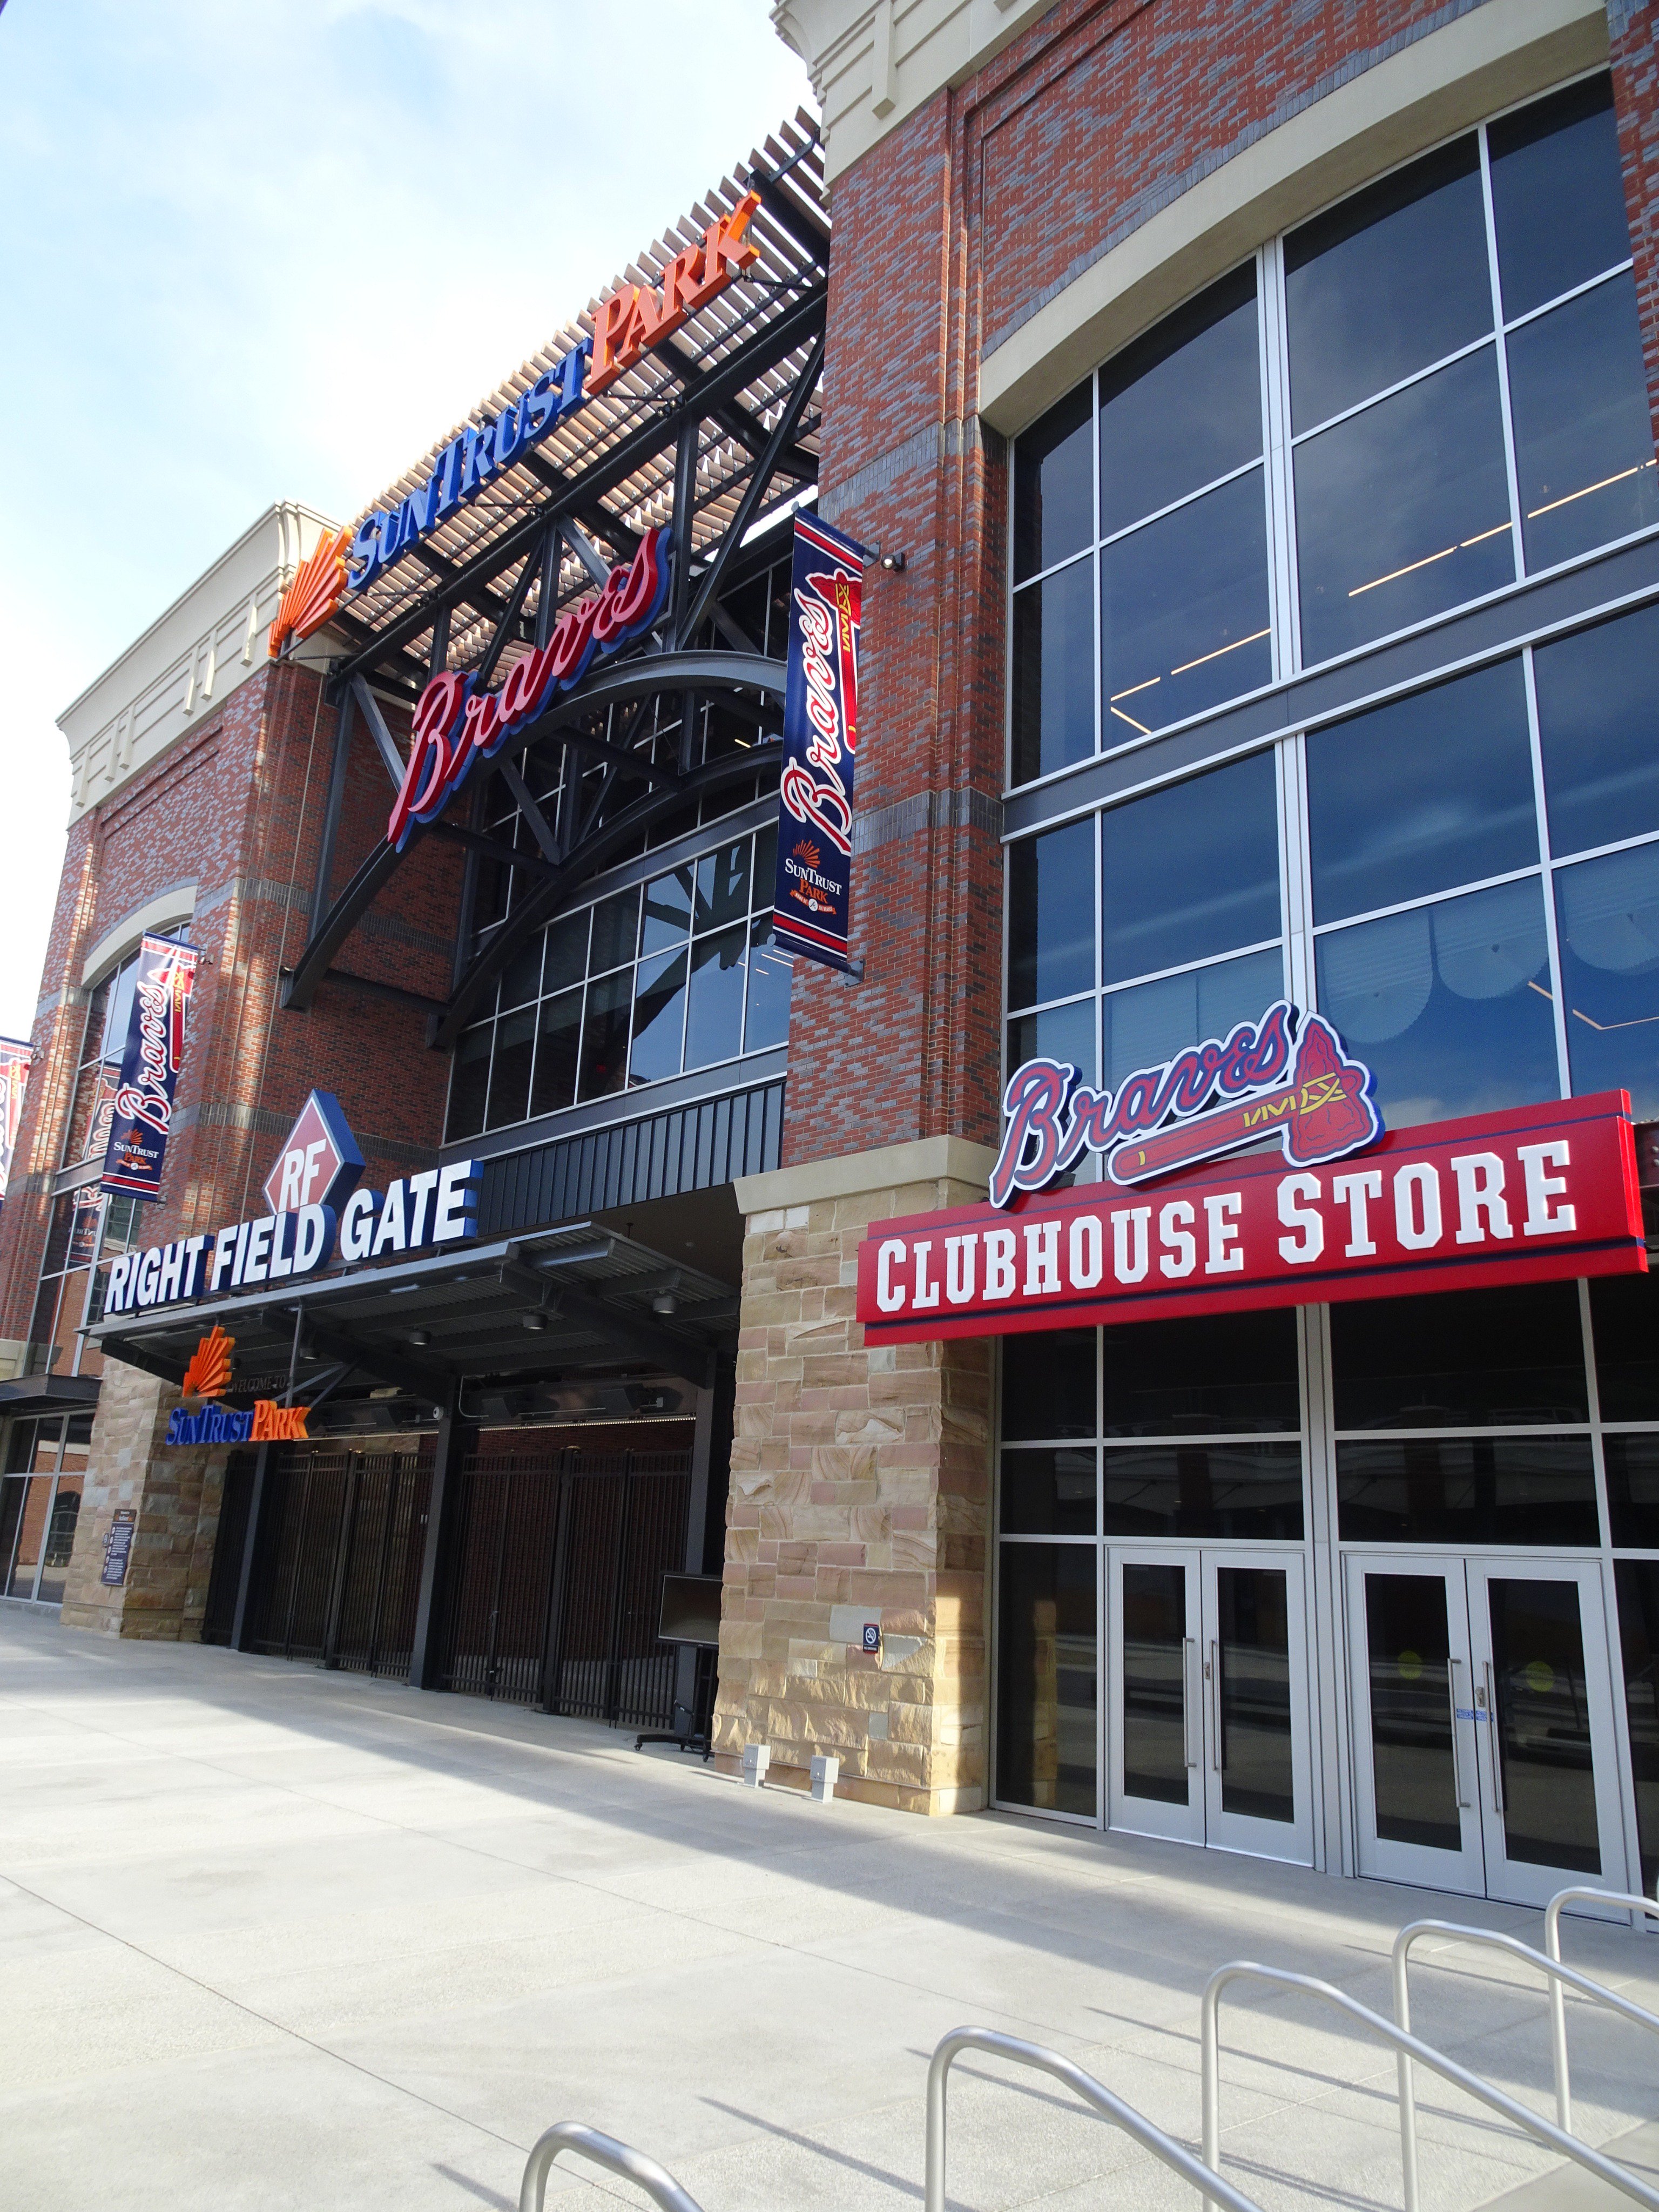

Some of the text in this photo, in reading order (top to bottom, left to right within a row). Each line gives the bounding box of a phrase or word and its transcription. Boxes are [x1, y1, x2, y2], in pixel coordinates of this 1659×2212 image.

[583, 190, 761, 394] PARK
[387, 528, 672, 852] Braves
[781, 588, 852, 858] Braves
[799, 878, 828, 904] PARK
[115, 981, 172, 1135] Braves
[990, 1000, 1299, 1210] Braves
[104, 1159, 485, 1313] RIGHT FIELD GATE
[279, 1139, 326, 1211] RF
[876, 1139, 1577, 1312] CLUBHOUSE STORE
[248, 1400, 311, 1441] PARK
